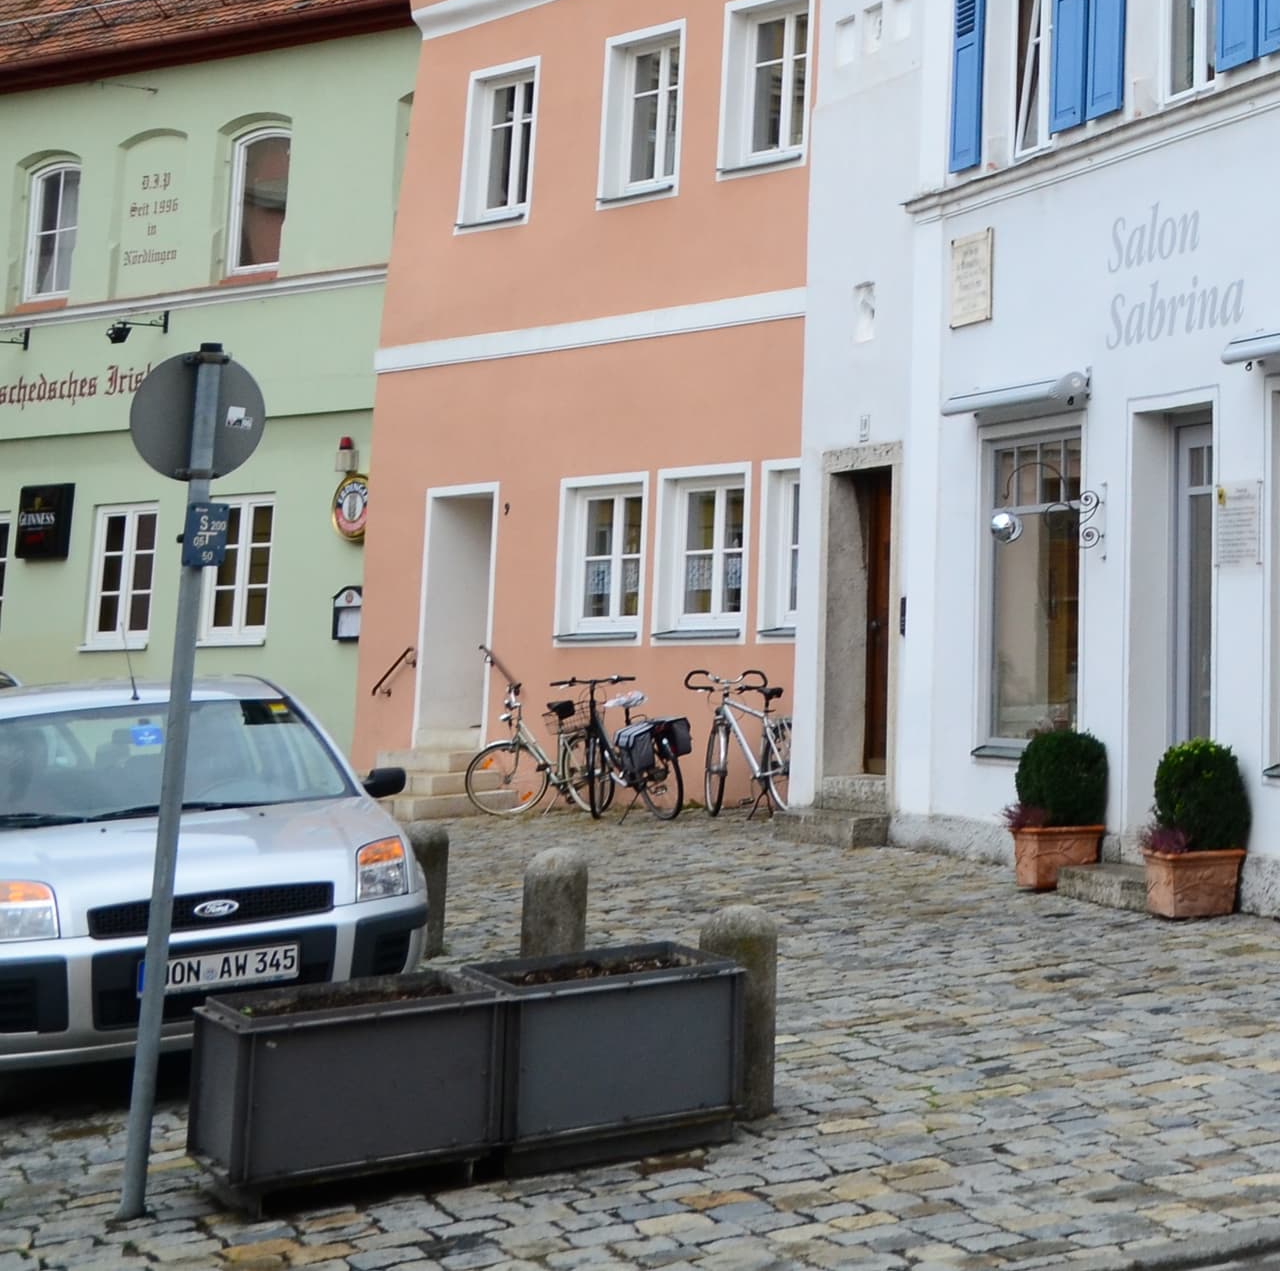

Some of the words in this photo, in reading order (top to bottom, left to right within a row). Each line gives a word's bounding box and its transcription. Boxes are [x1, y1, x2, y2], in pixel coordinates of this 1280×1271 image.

[130, 202, 149, 218] Seit
[153, 198, 179, 216] 1996
[147, 224, 157, 236] in
[1107, 200, 1201, 274] Salon
[123, 248, 177, 266] Nördlingen
[1105, 275, 1245, 351] Sabrina
[104, 361, 152, 396] Iris
[19, 512, 56, 526] GUINNESS
[211, 520, 226, 531] 200
[219, 954, 248, 979] AW
[255, 947, 296, 974] 345
